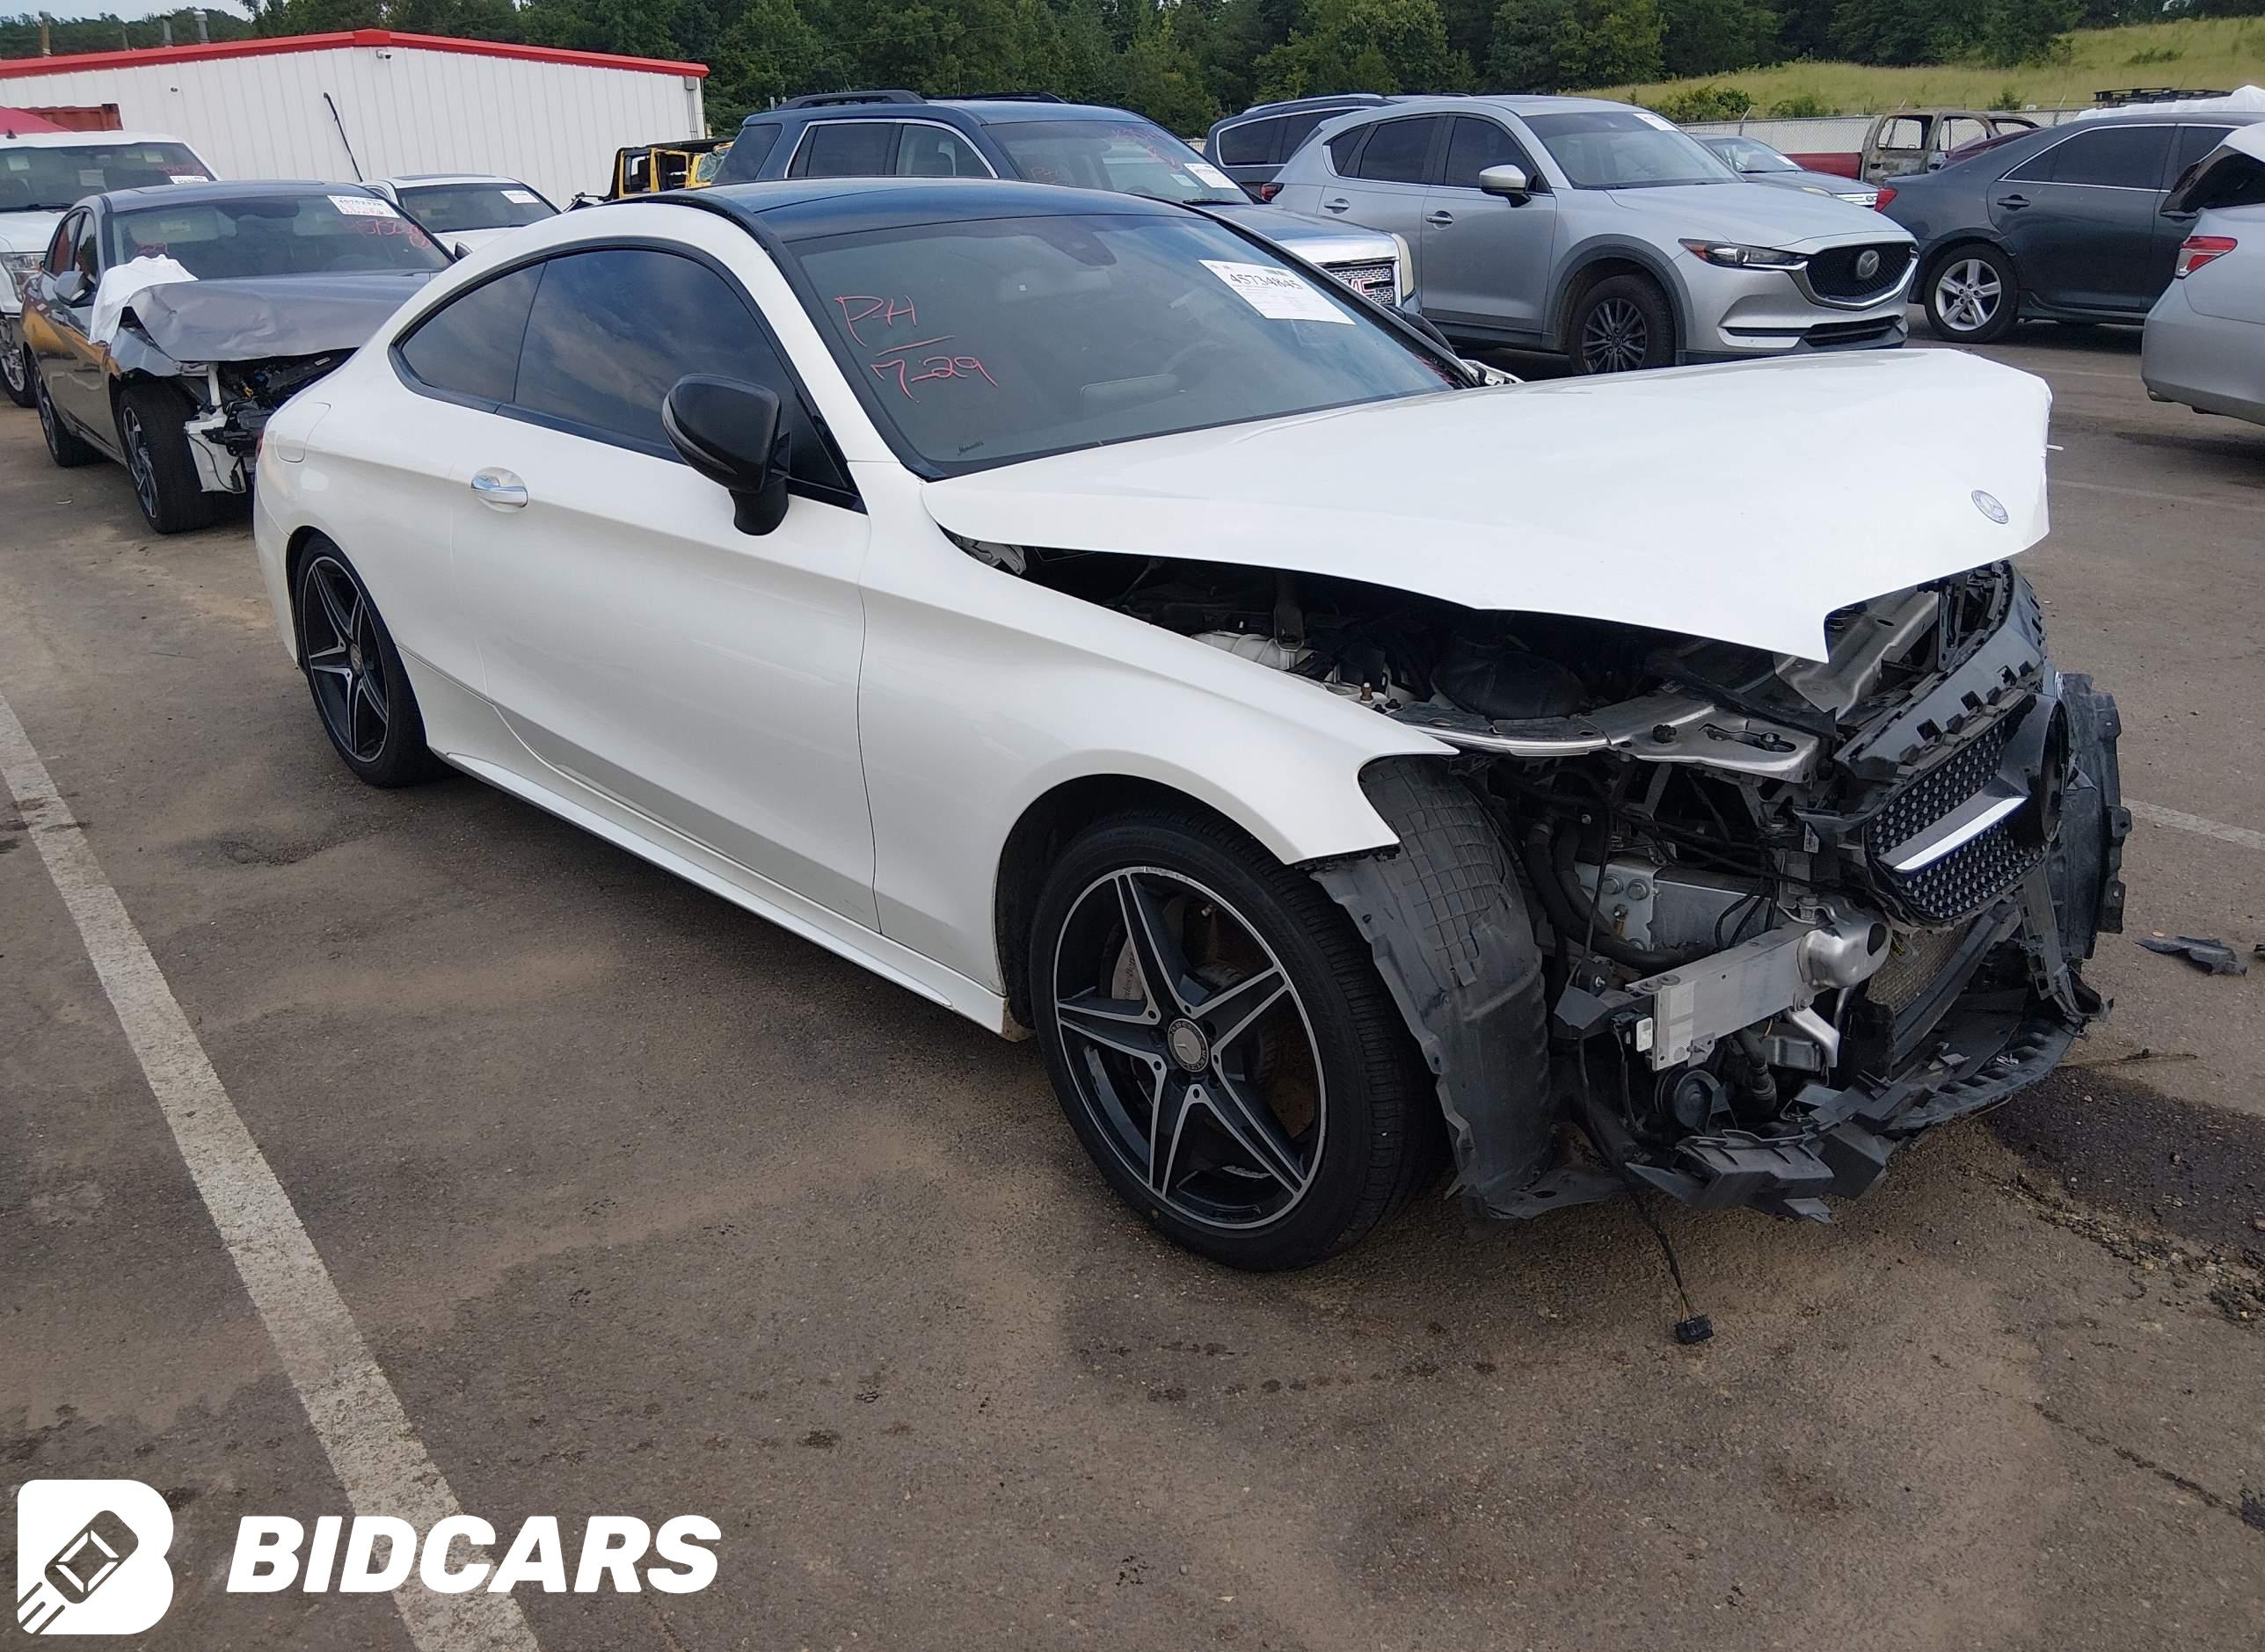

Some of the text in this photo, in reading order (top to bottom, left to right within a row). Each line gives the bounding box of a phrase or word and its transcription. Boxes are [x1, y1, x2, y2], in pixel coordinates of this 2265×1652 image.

[1230, 273, 1303, 290] 45734845
[834, 295, 918, 348] PH
[870, 355, 999, 402] 7-29
